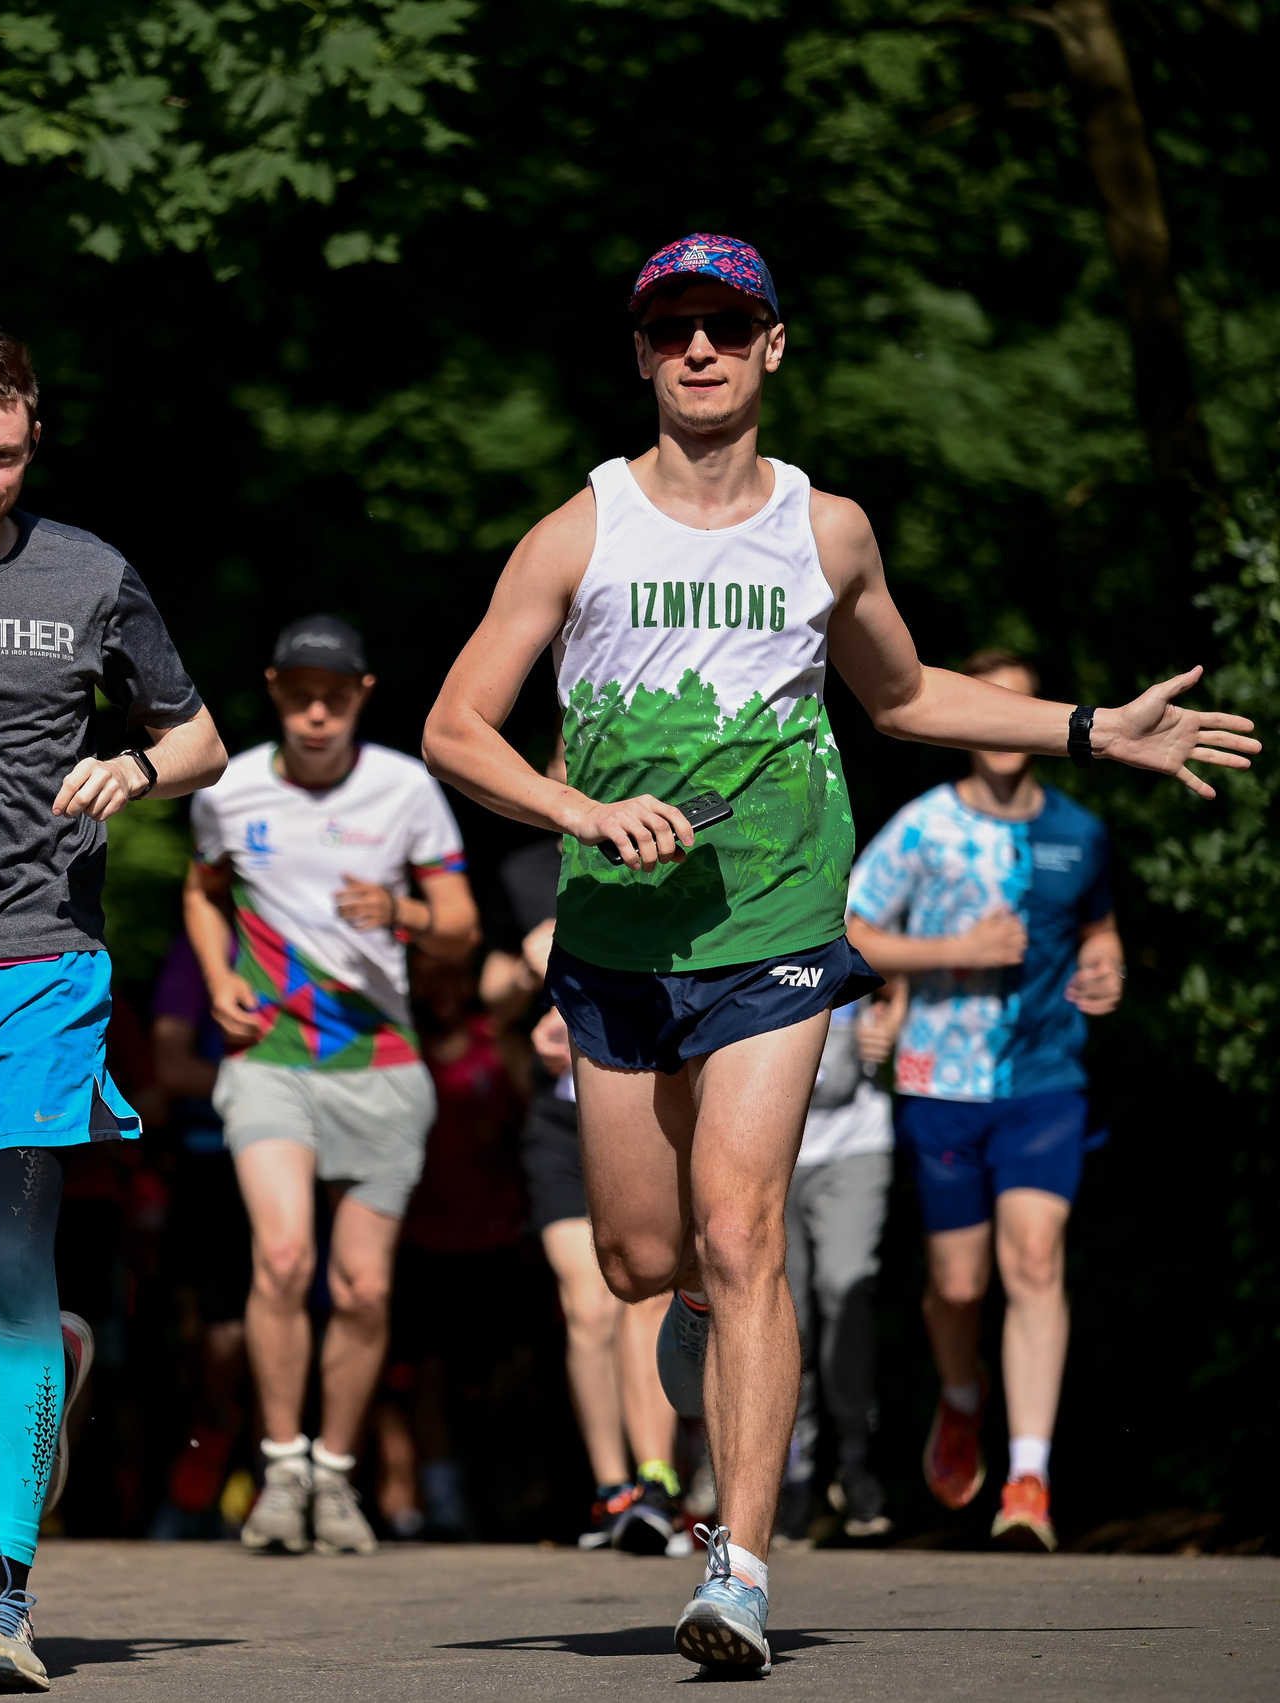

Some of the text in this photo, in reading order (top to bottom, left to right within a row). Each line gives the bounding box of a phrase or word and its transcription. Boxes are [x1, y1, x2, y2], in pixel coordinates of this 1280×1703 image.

[630, 581, 786, 633] IZMYLONG
[29, 650, 61, 659] SHARPENS
[768, 965, 824, 988] RAY
